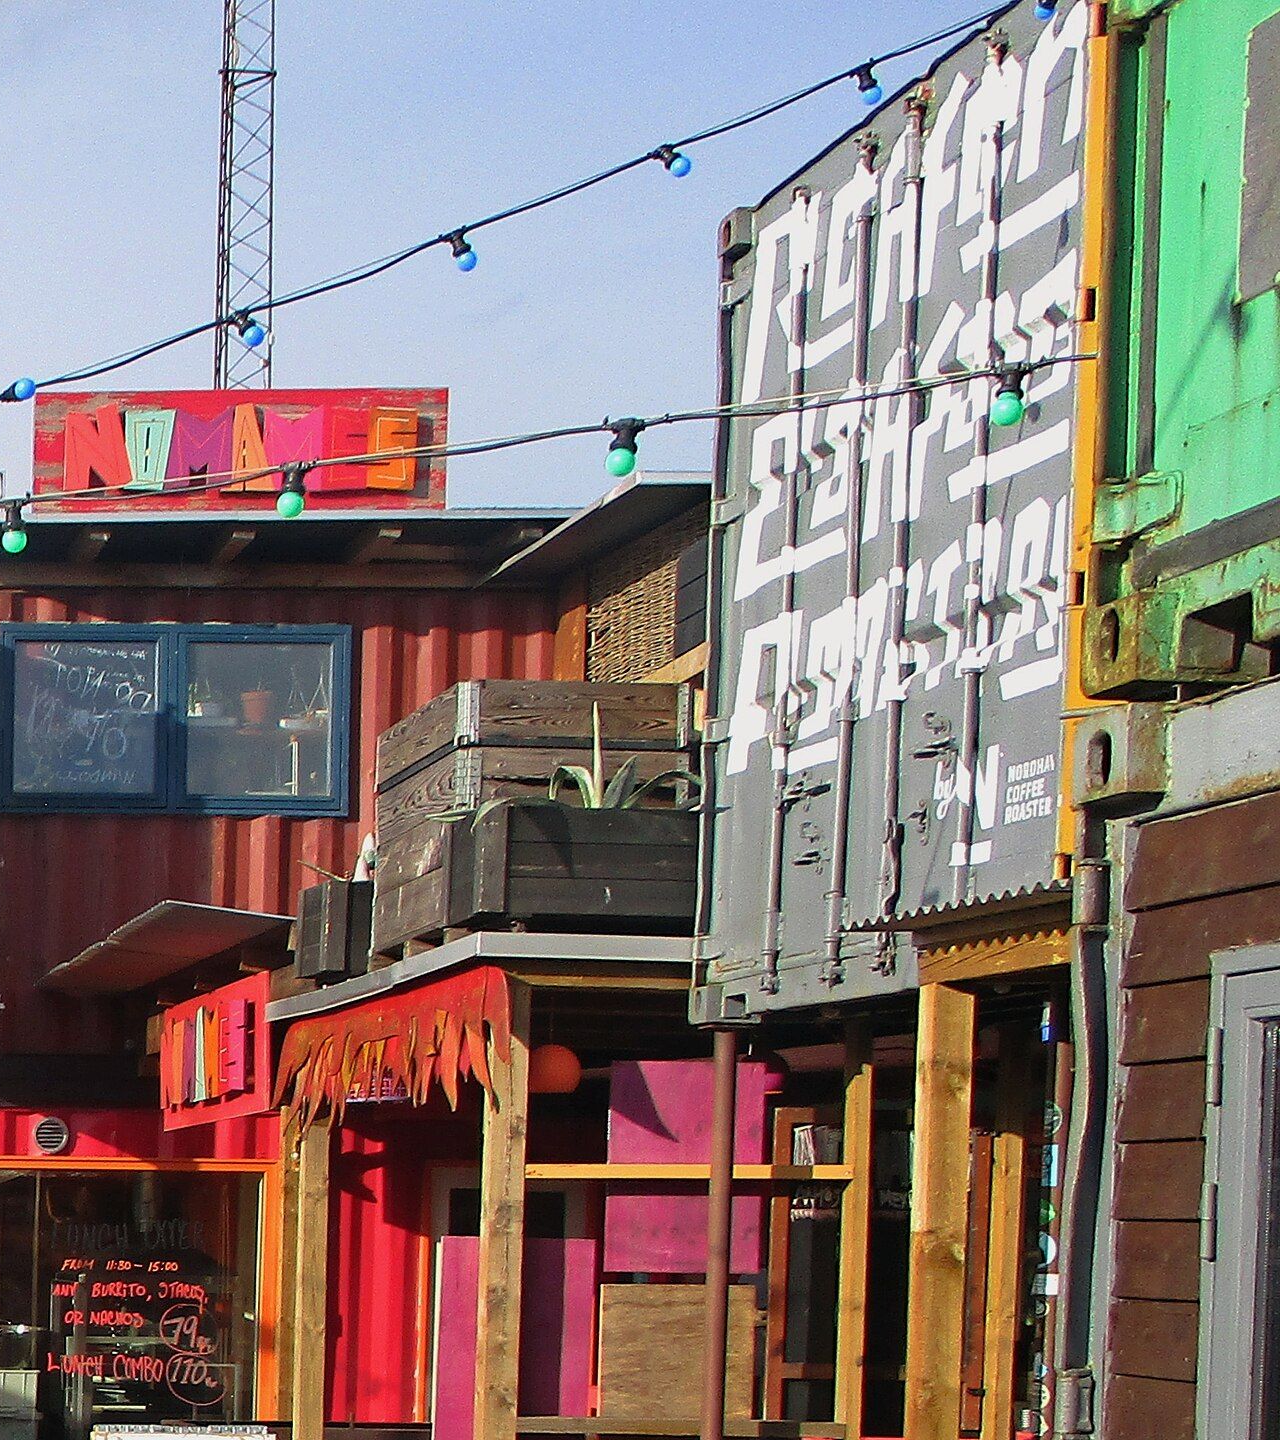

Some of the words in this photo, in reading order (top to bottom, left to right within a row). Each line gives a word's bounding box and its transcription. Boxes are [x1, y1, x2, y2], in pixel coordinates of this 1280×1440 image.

[63, 402, 420, 493] NOMAMES
[1006, 778, 1046, 804] COFFEE
[61, 1258, 95, 1271] FROM
[106, 1259, 133, 1271] 11:30
[148, 1260, 179, 1272] 15:00
[53, 1282, 80, 1297] ANY
[64, 1311, 84, 1325] OR
[89, 1311, 145, 1328] NACHOS
[46, 1352, 105, 1377] LUNCH
[113, 1354, 165, 1383] COMBO
